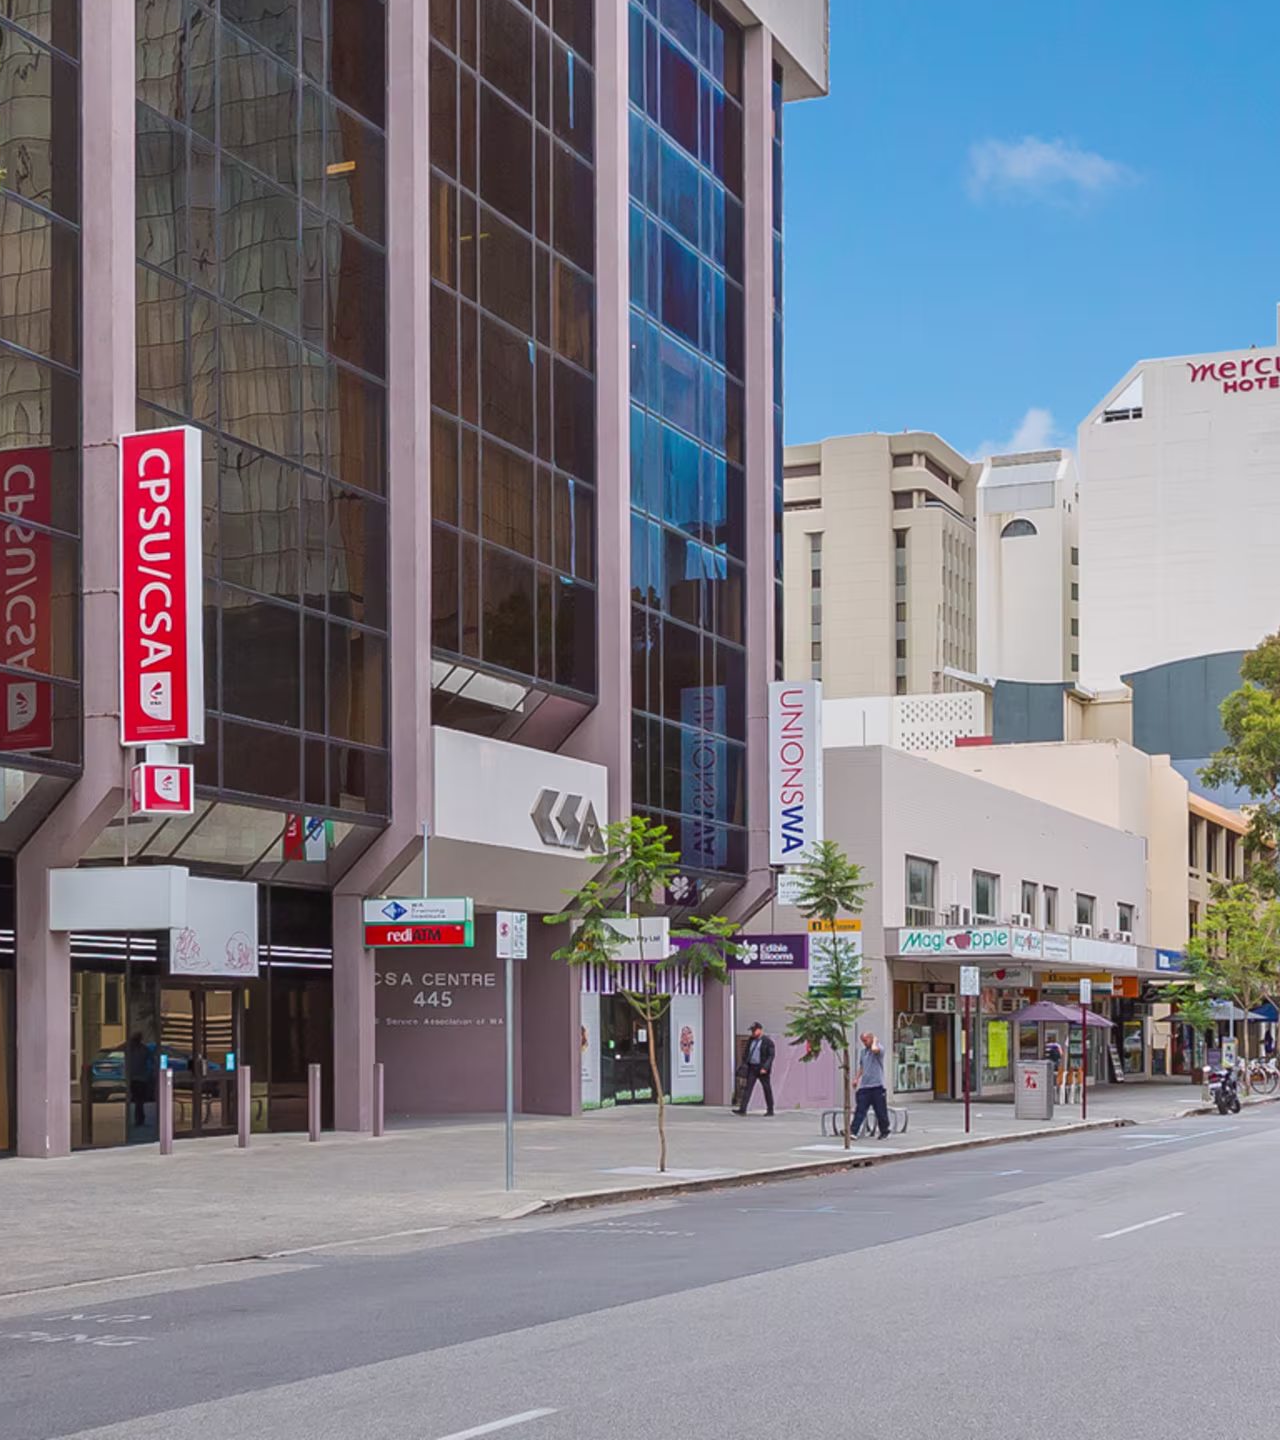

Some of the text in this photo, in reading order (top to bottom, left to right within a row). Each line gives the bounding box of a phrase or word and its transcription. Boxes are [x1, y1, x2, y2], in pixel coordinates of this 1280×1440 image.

[138, 448, 173, 668] CPSU/CSA
[386, 928, 441, 942] rediATM
[760, 944, 788, 953] Edible
[760, 953, 794, 961] Blooms
[422, 973, 496, 987] CENTRE
[413, 991, 453, 1007] 445
